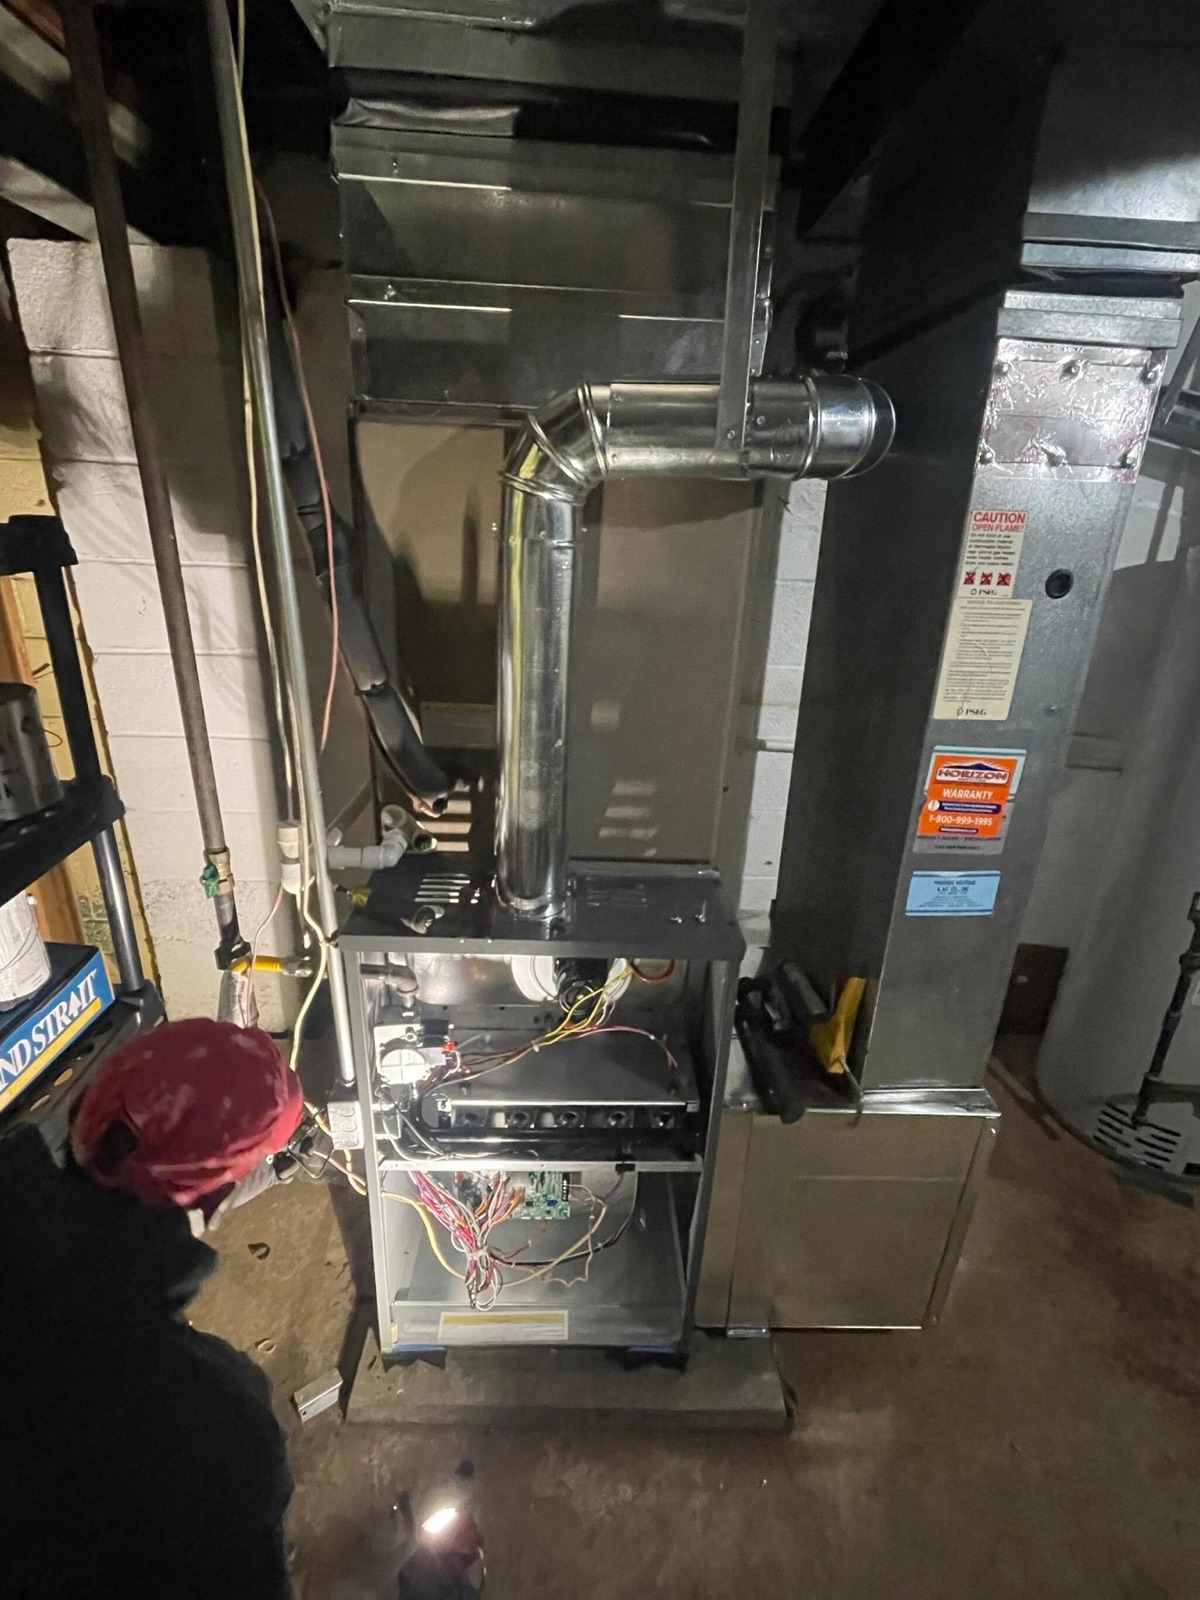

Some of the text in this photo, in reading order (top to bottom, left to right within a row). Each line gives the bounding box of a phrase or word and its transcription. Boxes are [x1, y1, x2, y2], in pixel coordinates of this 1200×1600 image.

[973, 511, 1026, 524] CAUTION
[971, 523, 993, 532] OPEN
[938, 769, 1007, 781] HORIZON
[942, 788, 994, 800] WARRANTY
[928, 814, 994, 826] 1-800-999-1995
